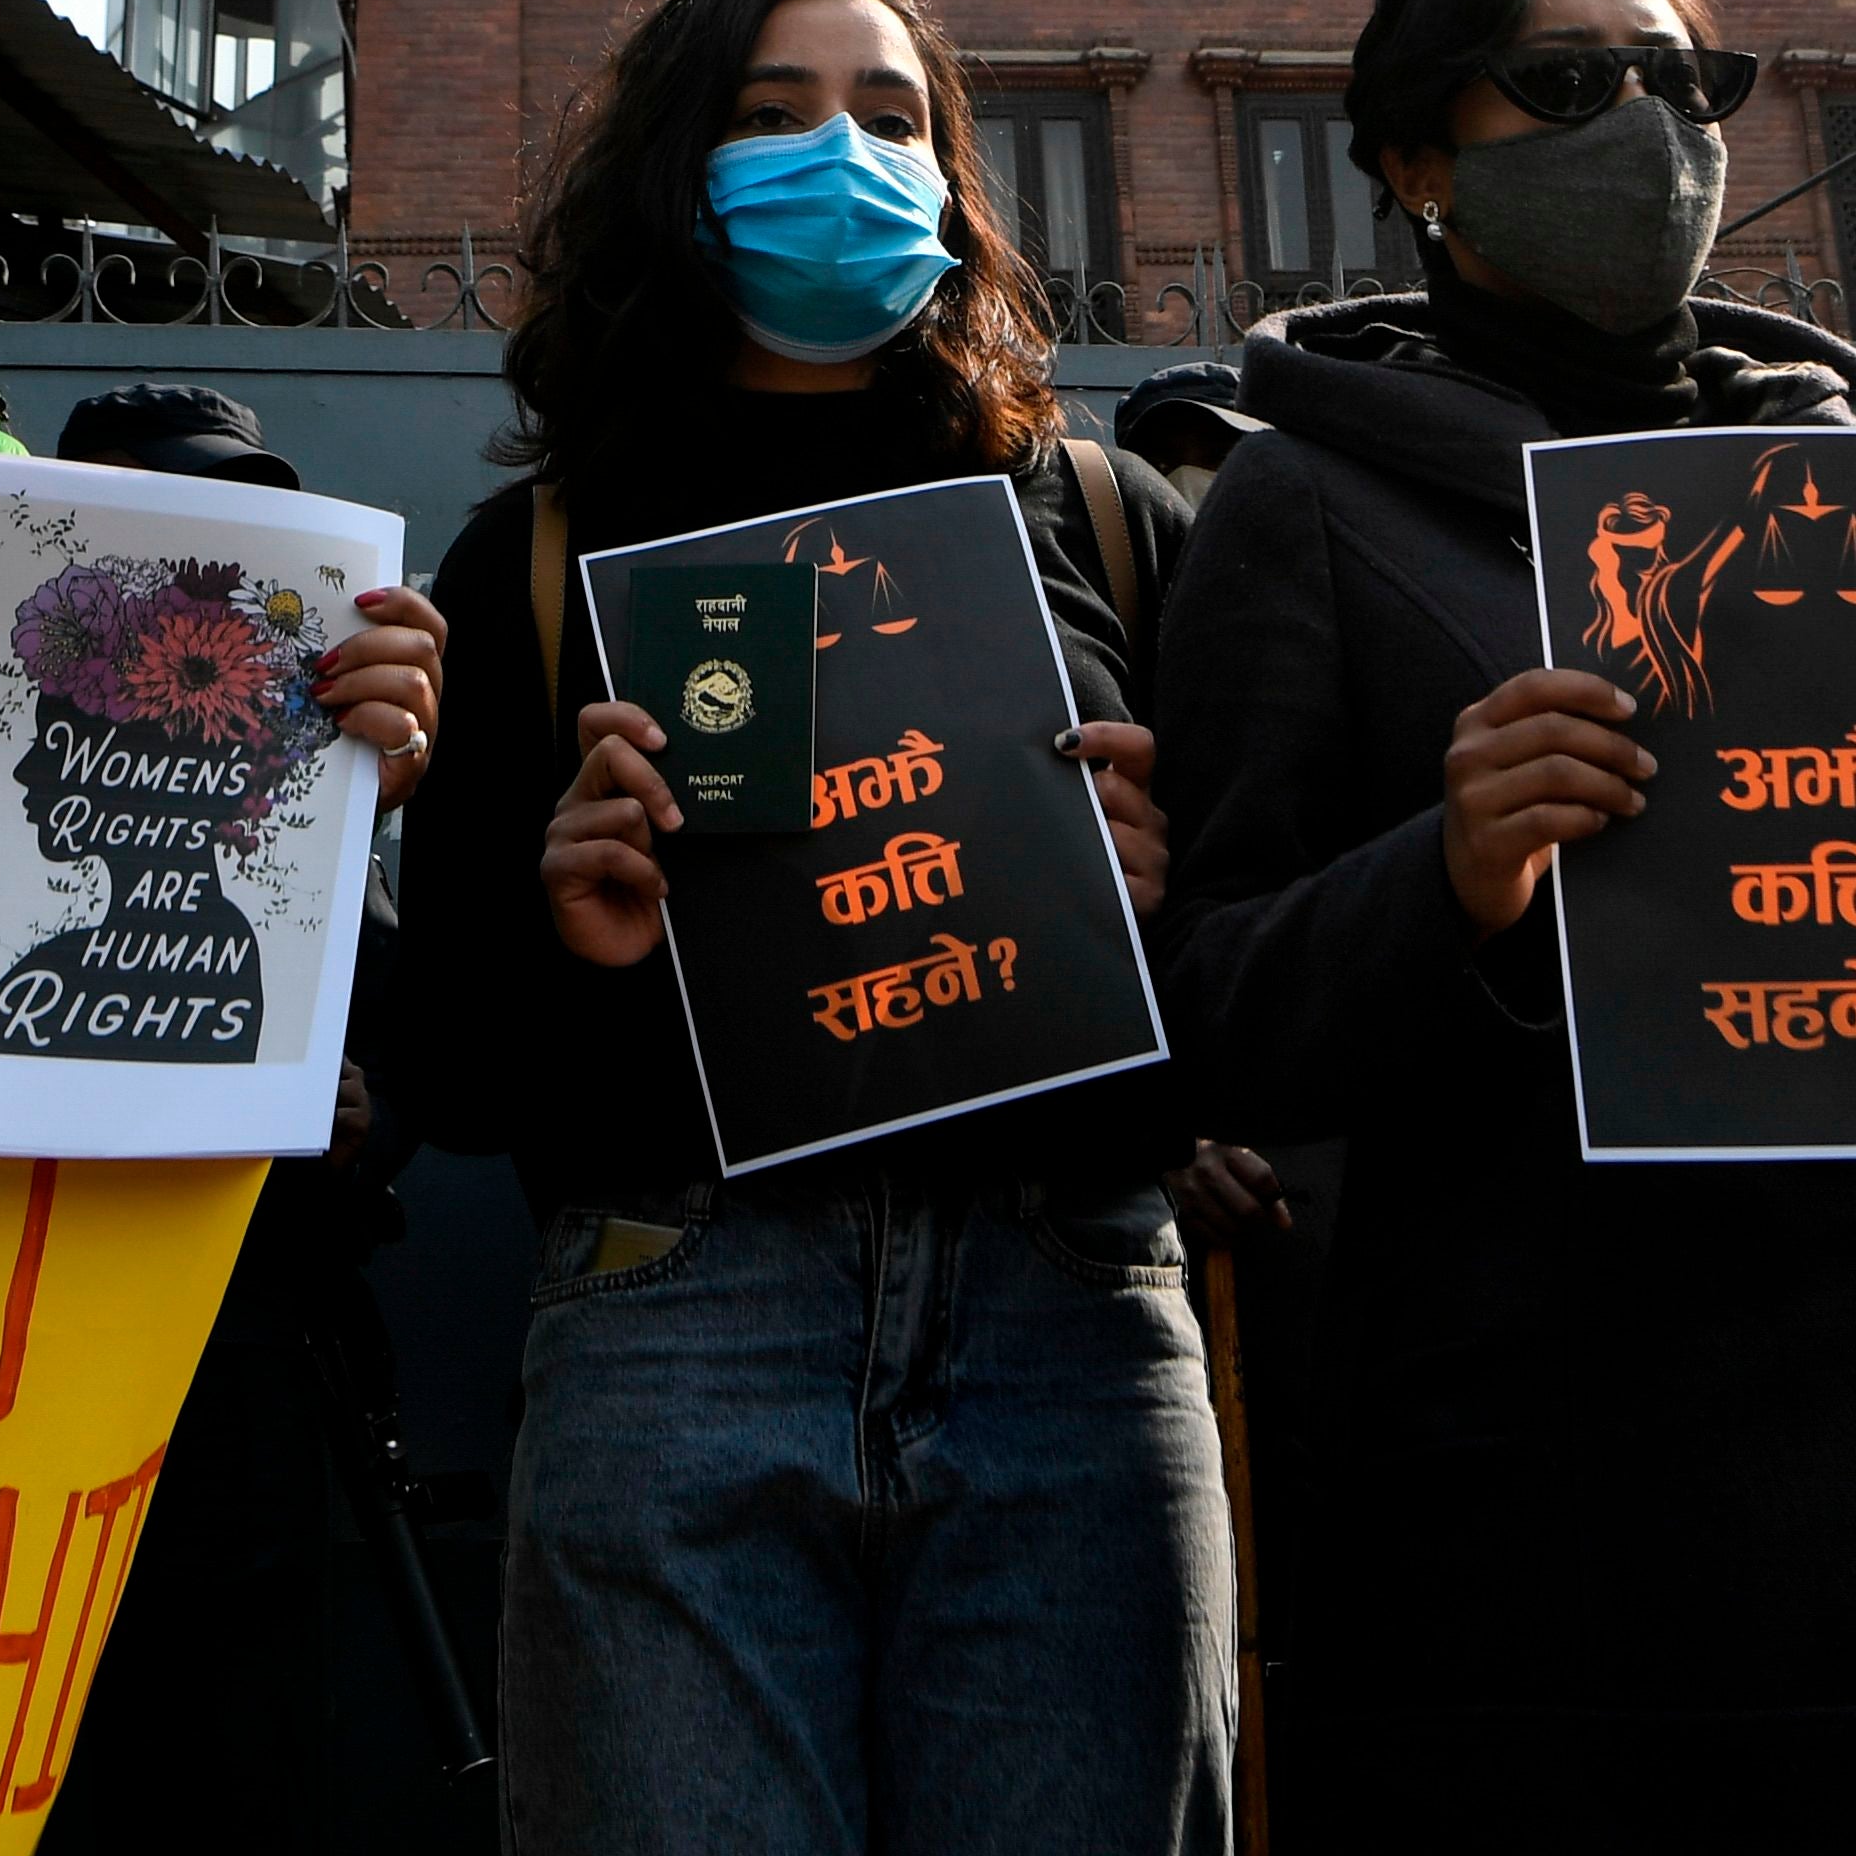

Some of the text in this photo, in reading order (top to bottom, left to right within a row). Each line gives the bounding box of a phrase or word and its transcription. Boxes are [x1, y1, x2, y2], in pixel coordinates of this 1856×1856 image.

[695, 593, 747, 613] राहदानी
[702, 614, 740, 633] नेपाल
[46, 721, 250, 798] WOMEN'S
[688, 774, 745, 786] PASSPORT
[697, 790, 734, 801] NEPAL
[49, 795, 212, 855] RIGHTS
[125, 870, 209, 912] ARE
[81, 929, 250, 976] HUMAN
